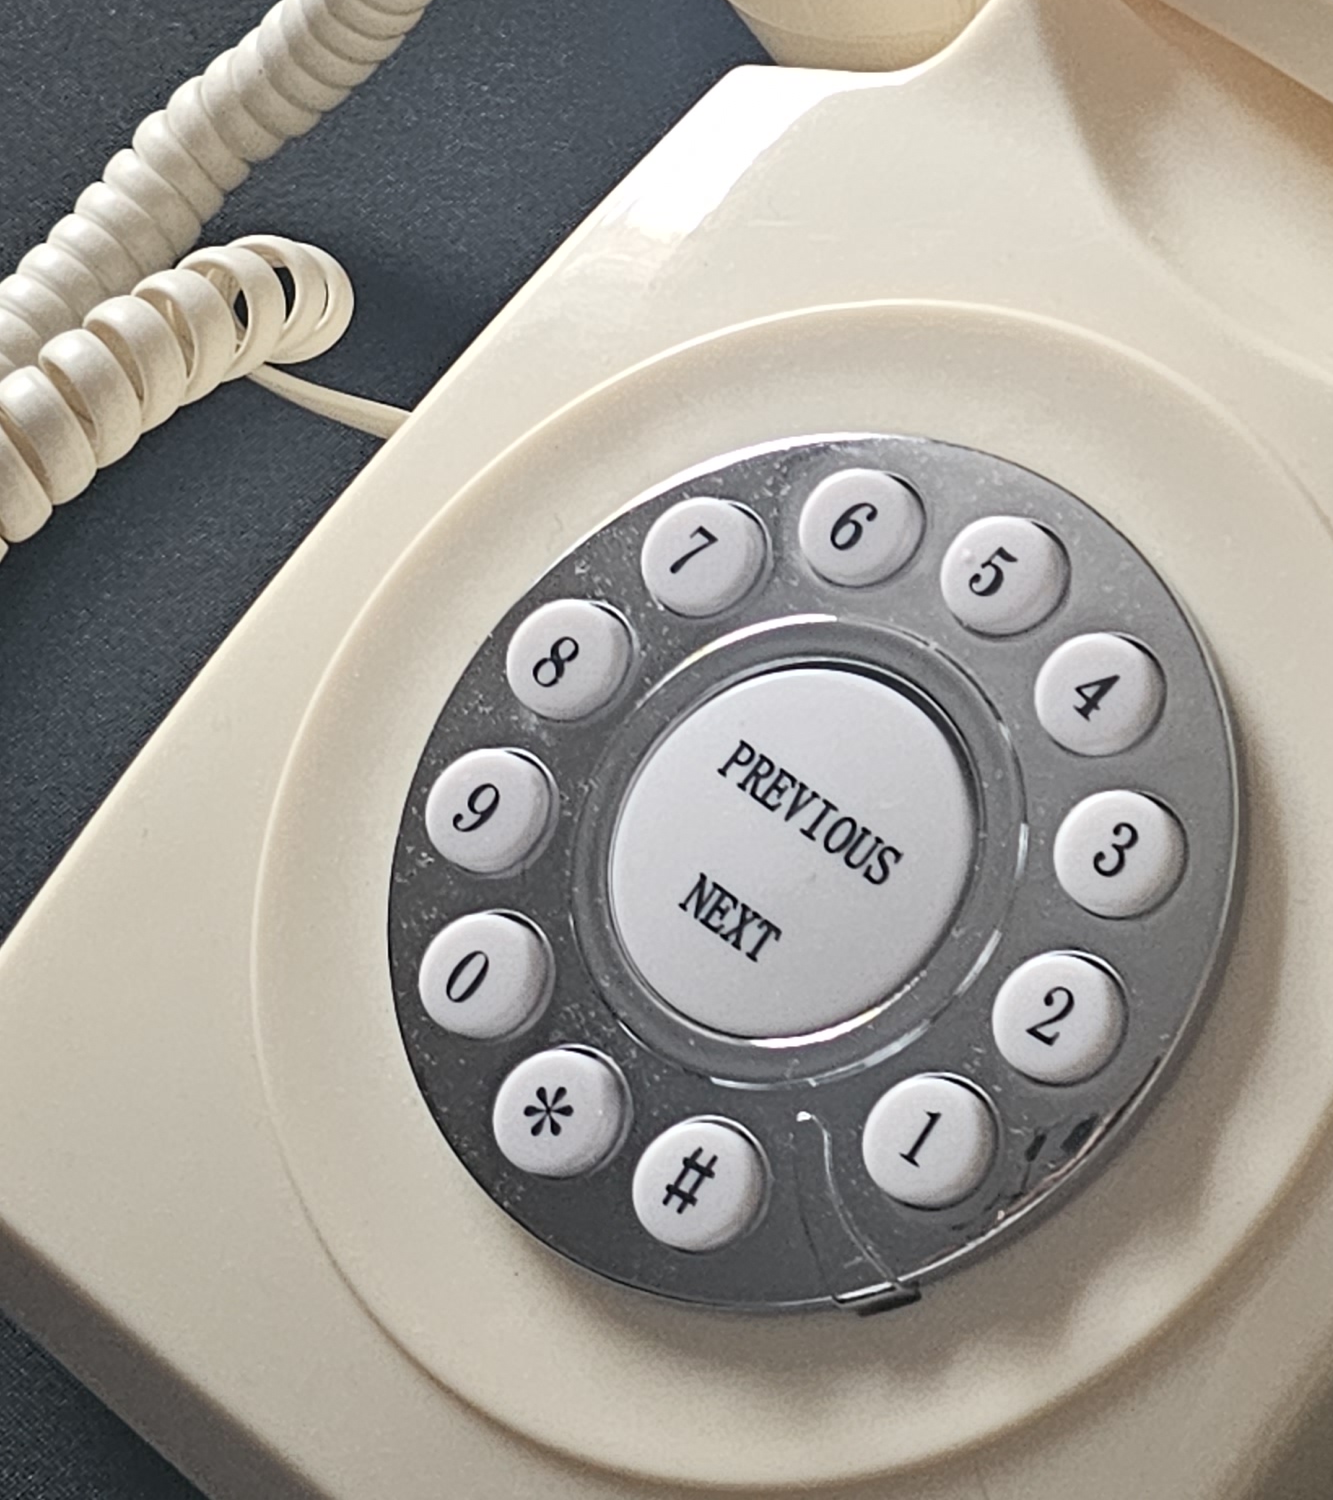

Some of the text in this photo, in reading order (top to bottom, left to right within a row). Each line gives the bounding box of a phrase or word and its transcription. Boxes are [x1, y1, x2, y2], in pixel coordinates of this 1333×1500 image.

[668, 527, 718, 575] 7
[829, 502, 878, 552] 6
[968, 549, 1018, 596] 5
[531, 636, 581, 689] 8
[1074, 673, 1121, 721] 4
[451, 782, 501, 833] 9
[717, 739, 903, 887] PREVIOUS
[1091, 822, 1140, 877] 3
[677, 873, 782, 963] NEXT
[445, 950, 491, 1004] 0
[1025, 987, 1076, 1046] 2
[899, 1112, 941, 1167] 1
